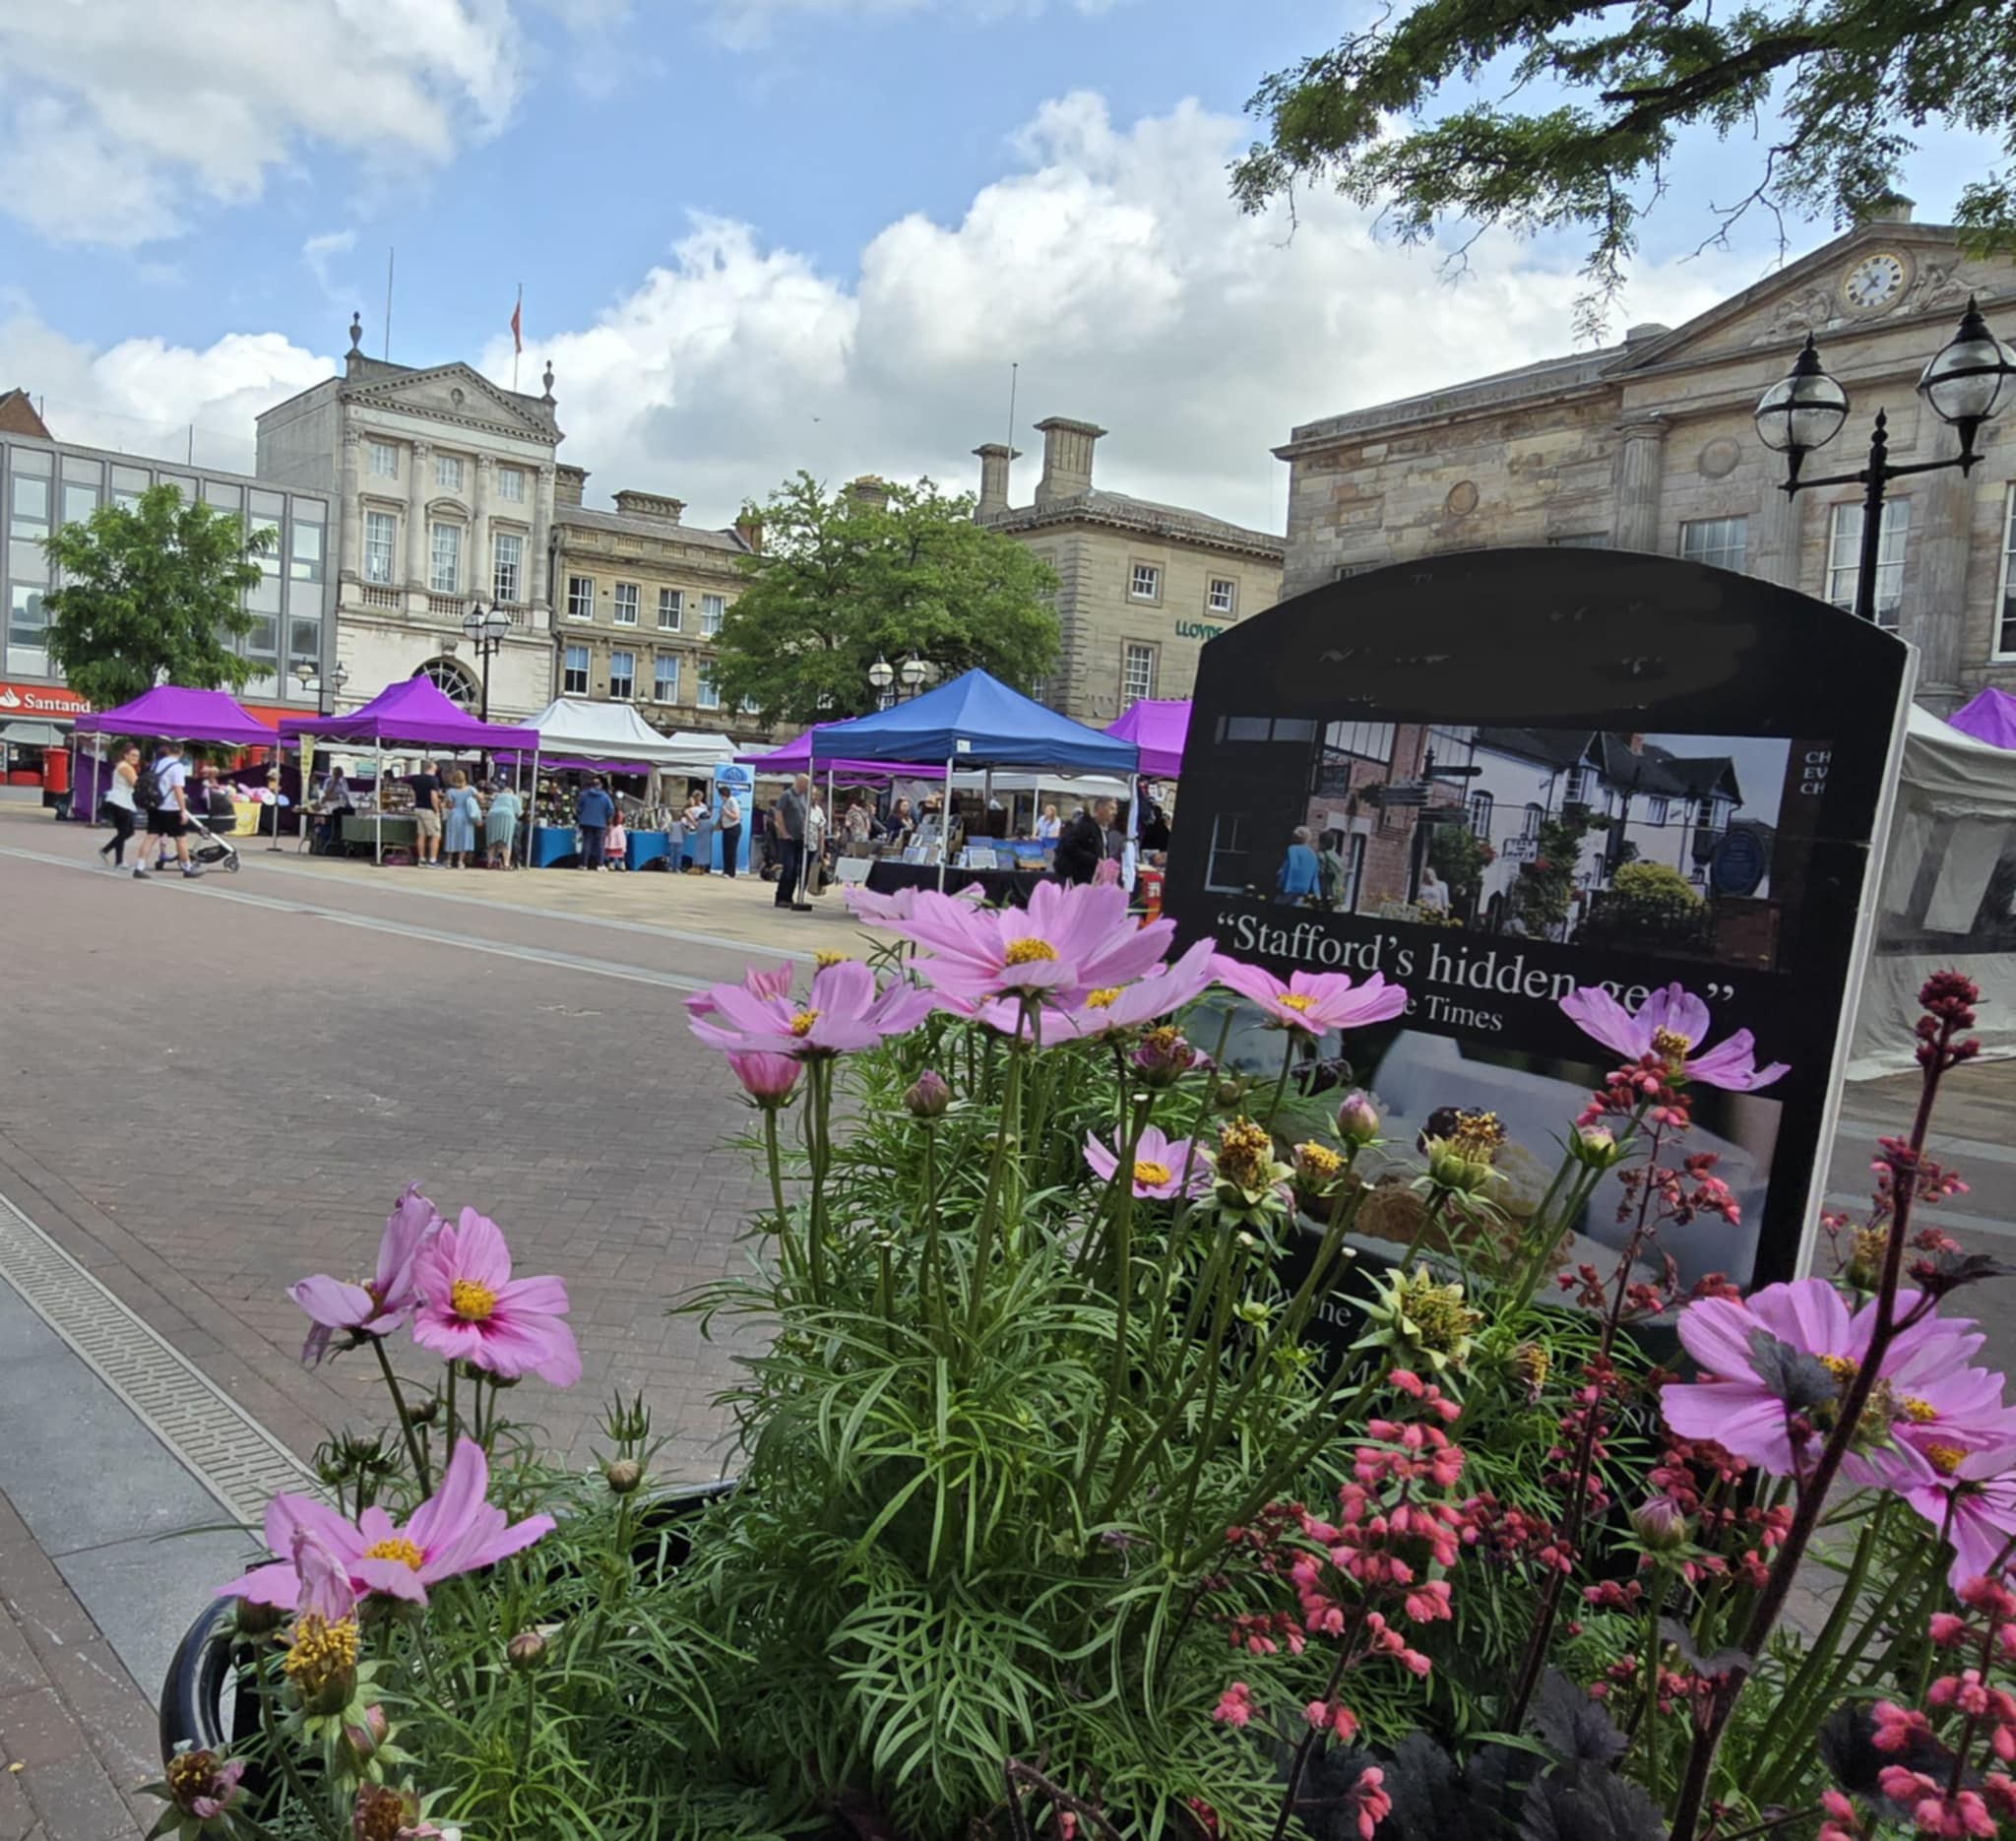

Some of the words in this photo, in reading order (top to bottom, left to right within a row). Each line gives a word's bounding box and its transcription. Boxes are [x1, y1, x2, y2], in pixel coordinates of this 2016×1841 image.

[1175, 619, 1225, 640] LLOYD
[24, 693, 92, 714] Santand
[1425, 942, 1576, 1001] hidden
[1424, 994, 1504, 1032] Times
